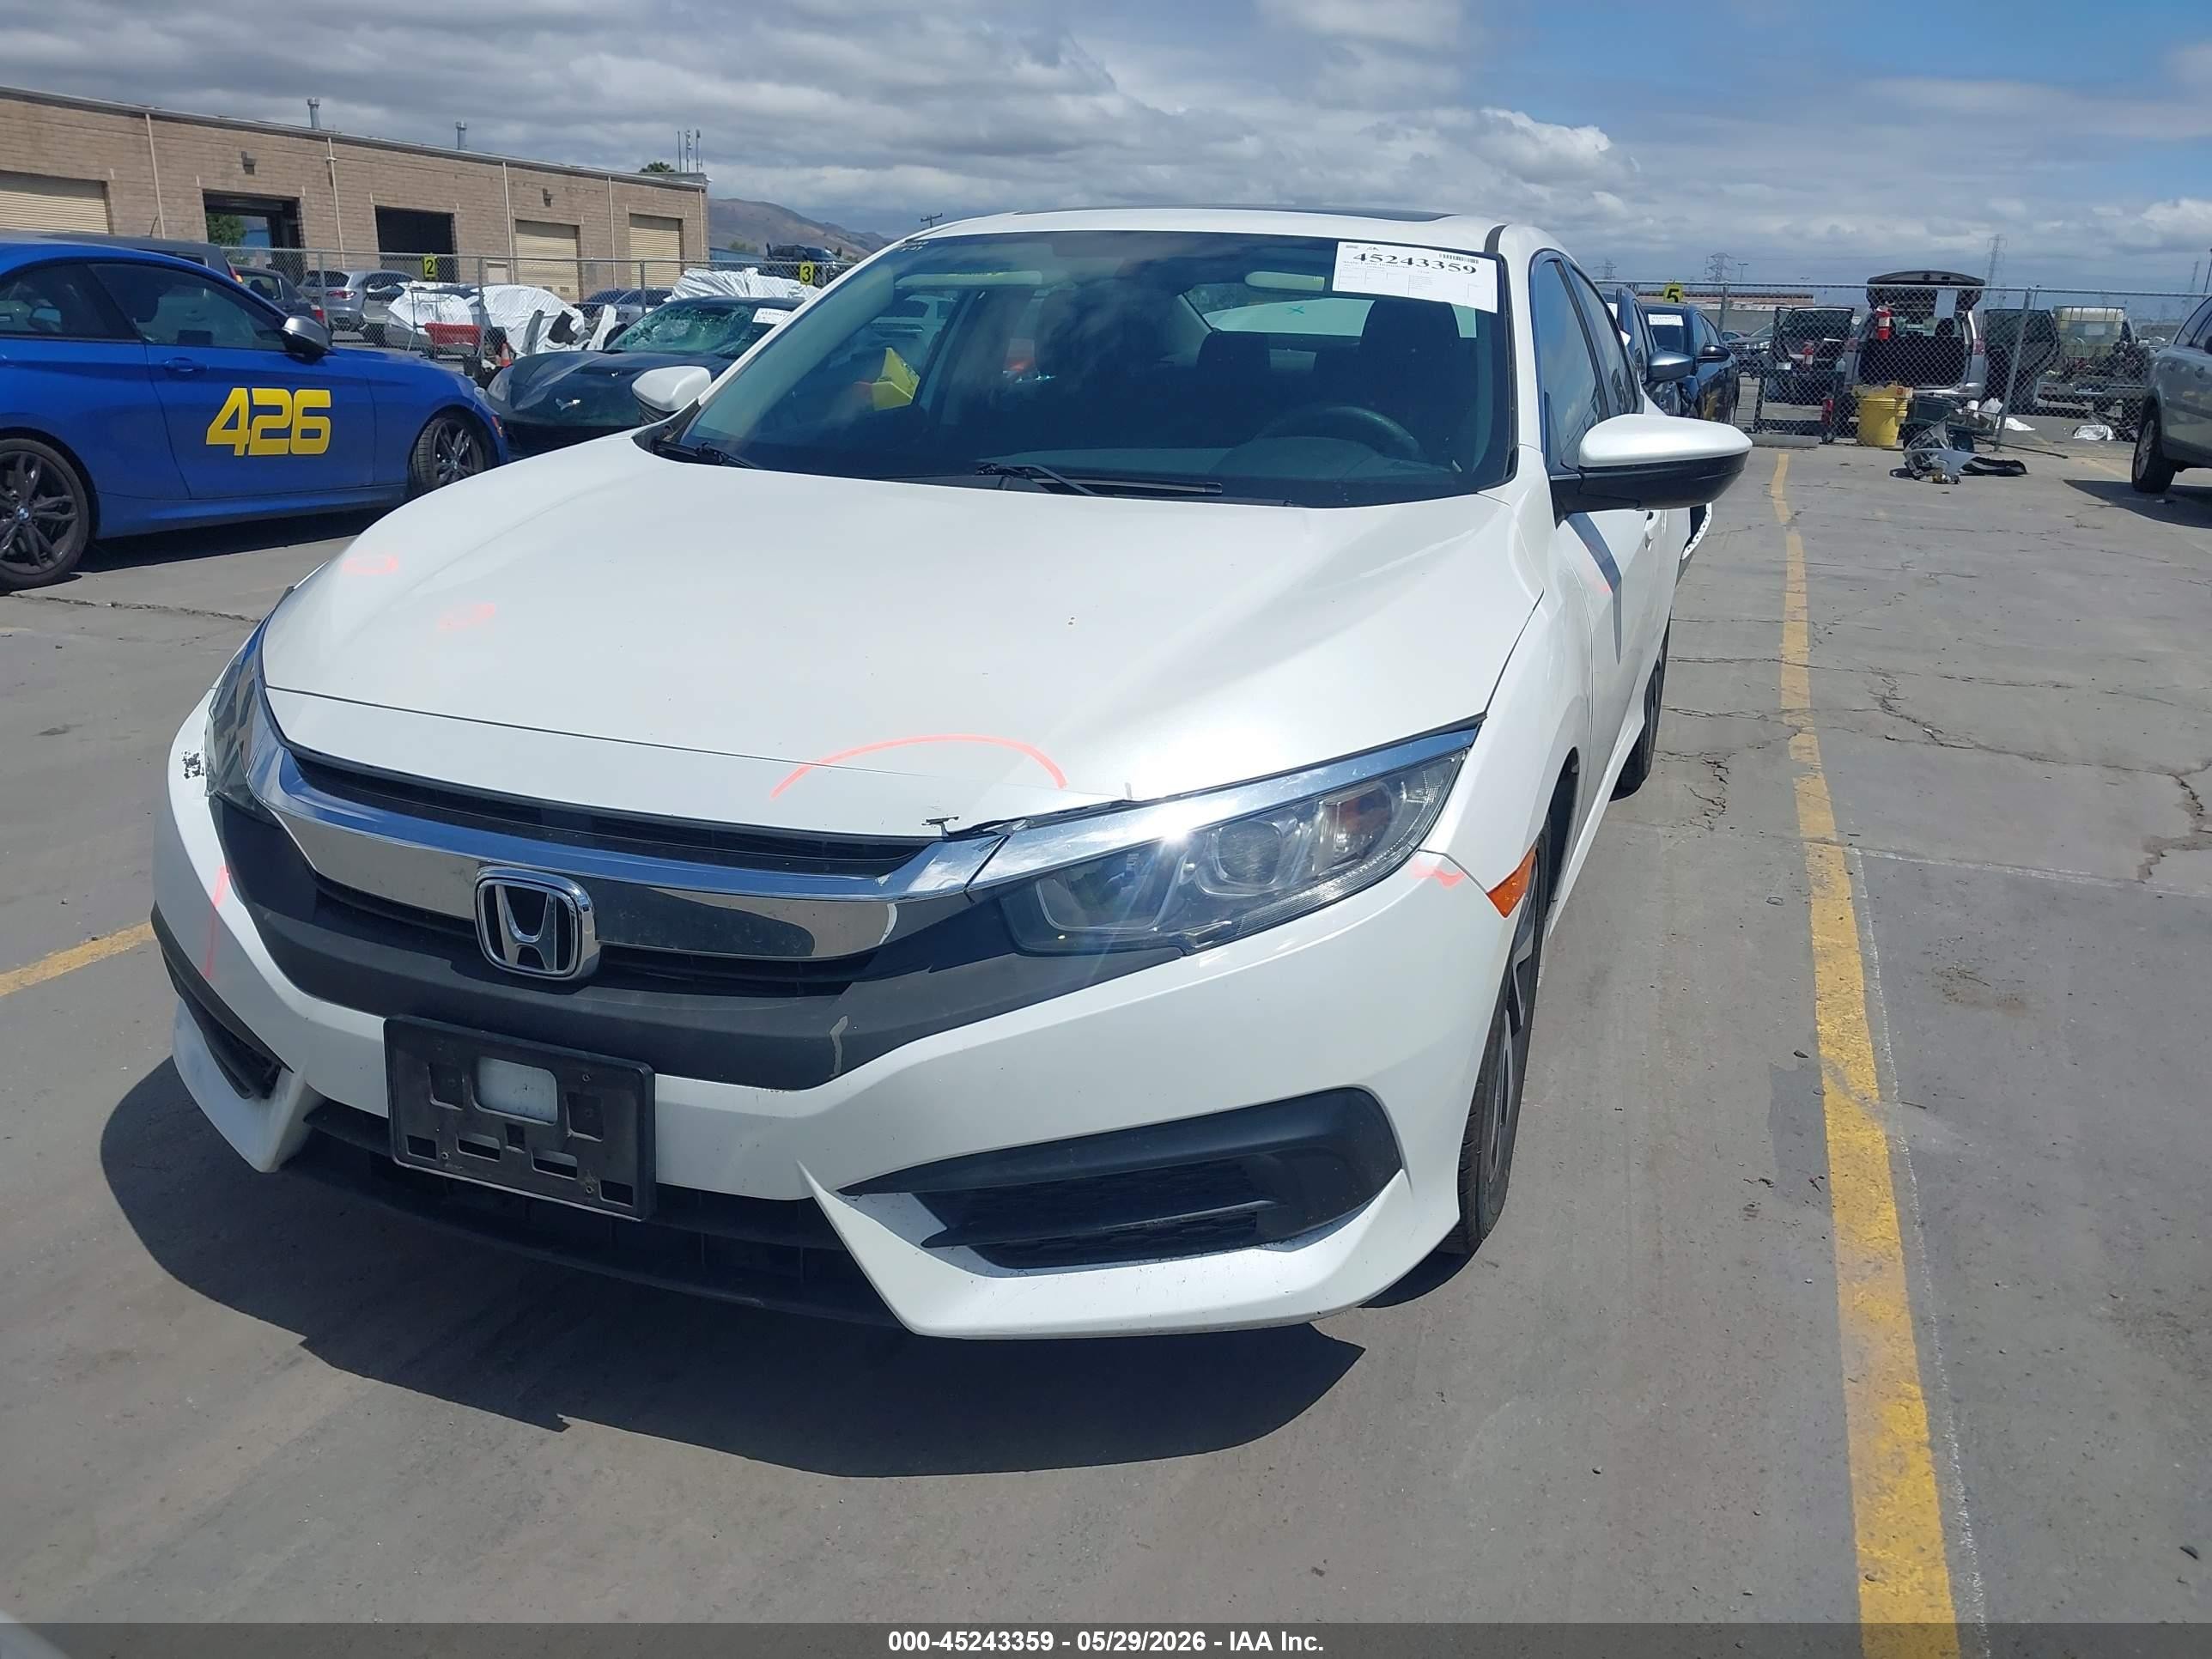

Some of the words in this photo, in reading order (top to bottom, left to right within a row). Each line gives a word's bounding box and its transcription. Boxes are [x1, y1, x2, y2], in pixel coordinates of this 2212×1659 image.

[425, 258, 434, 275] 2
[1352, 252, 1477, 275] 45243359
[801, 265, 811, 283] 3
[1666, 288, 1680, 303] 5
[205, 387, 332, 457] 426
